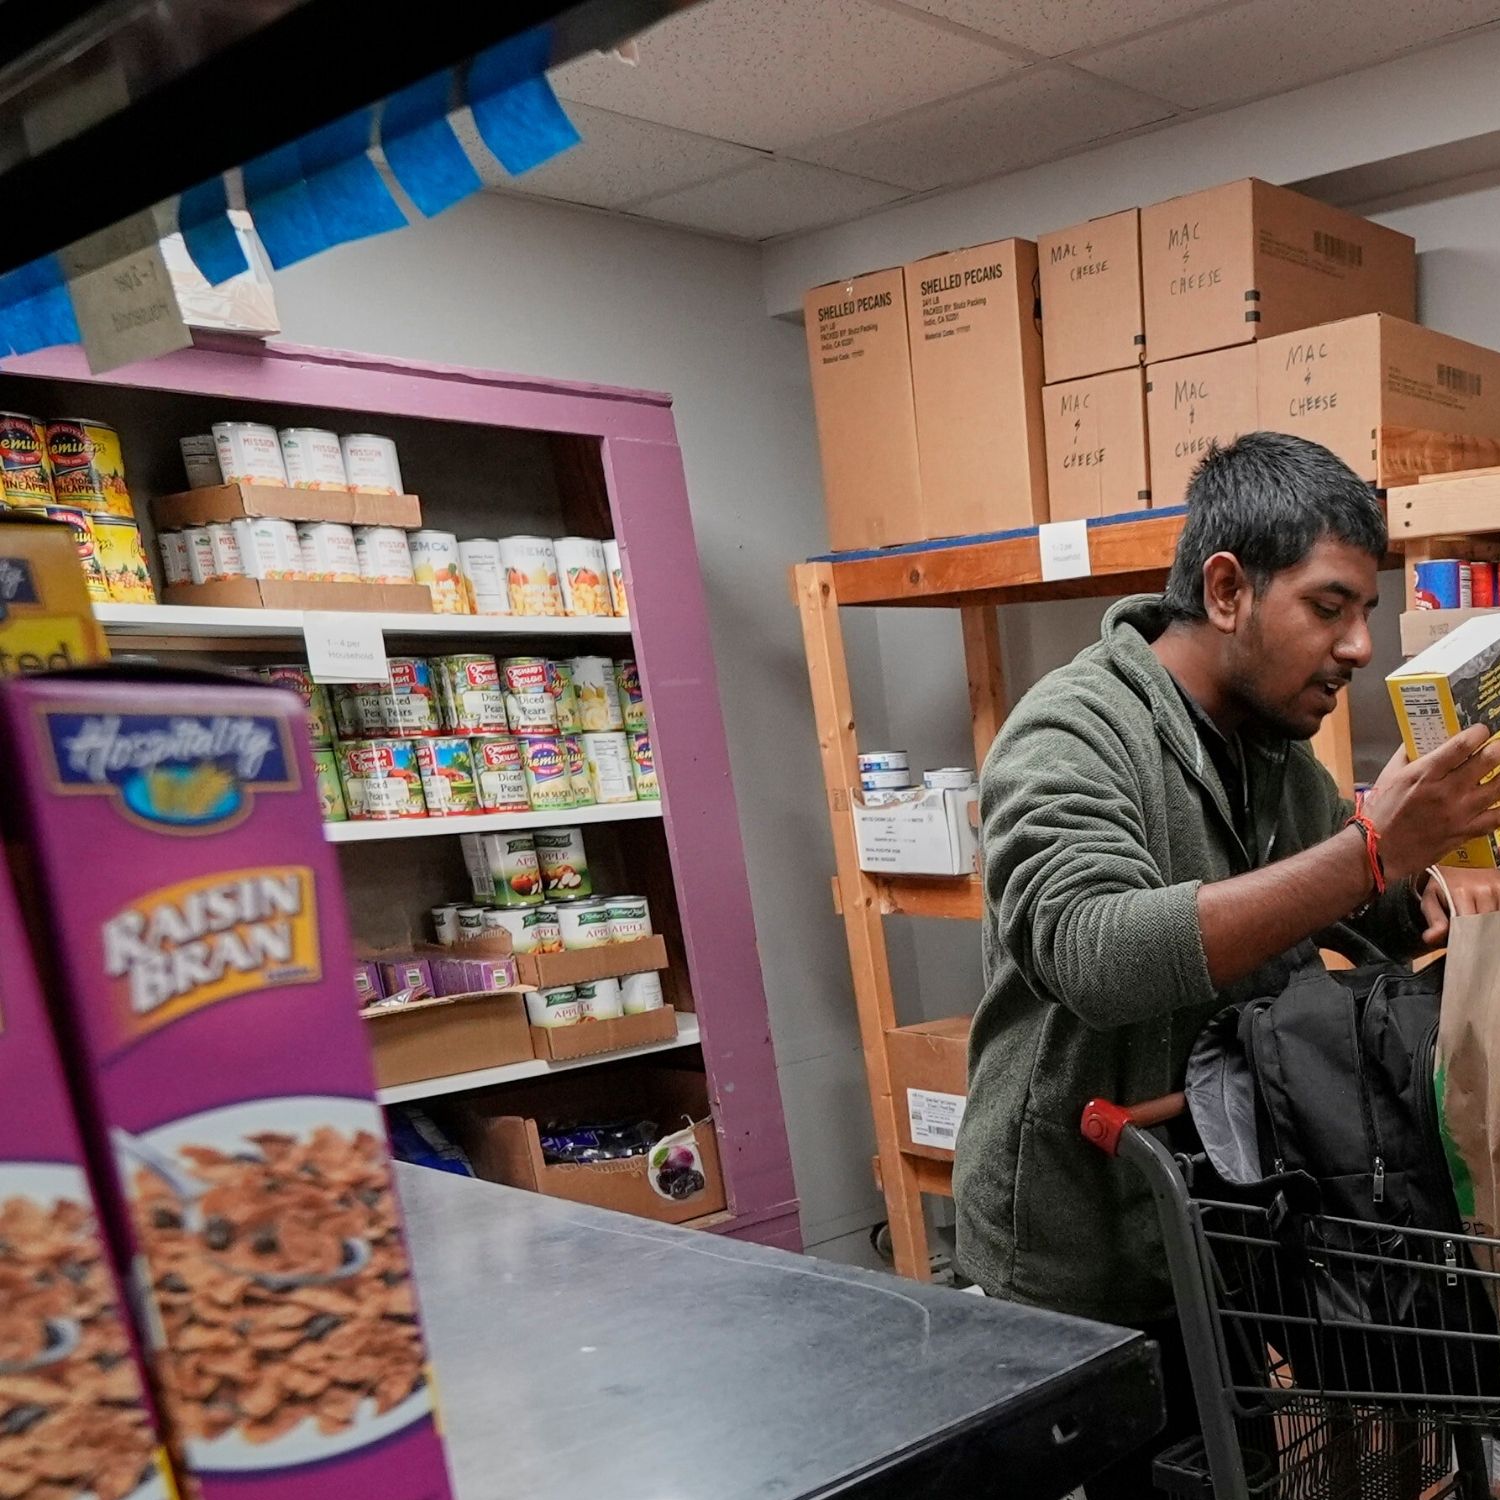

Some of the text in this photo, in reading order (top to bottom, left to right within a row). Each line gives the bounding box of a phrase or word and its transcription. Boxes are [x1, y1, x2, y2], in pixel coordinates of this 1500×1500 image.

[1168, 222, 1201, 250] MAC
[1050, 243, 1078, 265] MAC
[921, 264, 1003, 296] SHELLED PECANS
[1070, 260, 1109, 282] CHEESE
[1170, 268, 1222, 296] CHEESE
[818, 292, 892, 322] SHELLED PECANS
[1286, 343, 1328, 370] MAC
[1061, 394, 1090, 416] MAC
[1175, 381, 1208, 409] MAC
[1289, 393, 1337, 417] CHEESE
[243, 437, 275, 449] MISSION
[350, 448, 382, 458] MISSION
[1175, 435, 1219, 458] CHEESE
[1064, 448, 1106, 468] CHEESE
[384, 696, 411, 706] Diced
[519, 694, 544, 704] Diced
[387, 707, 413, 718] Pears
[522, 707, 546, 716] Pears
[498, 772, 522, 782] Diced
[501, 784, 524, 793] Pears
[104, 872, 303, 976] RAISIN
[130, 919, 295, 1016] BRAN
